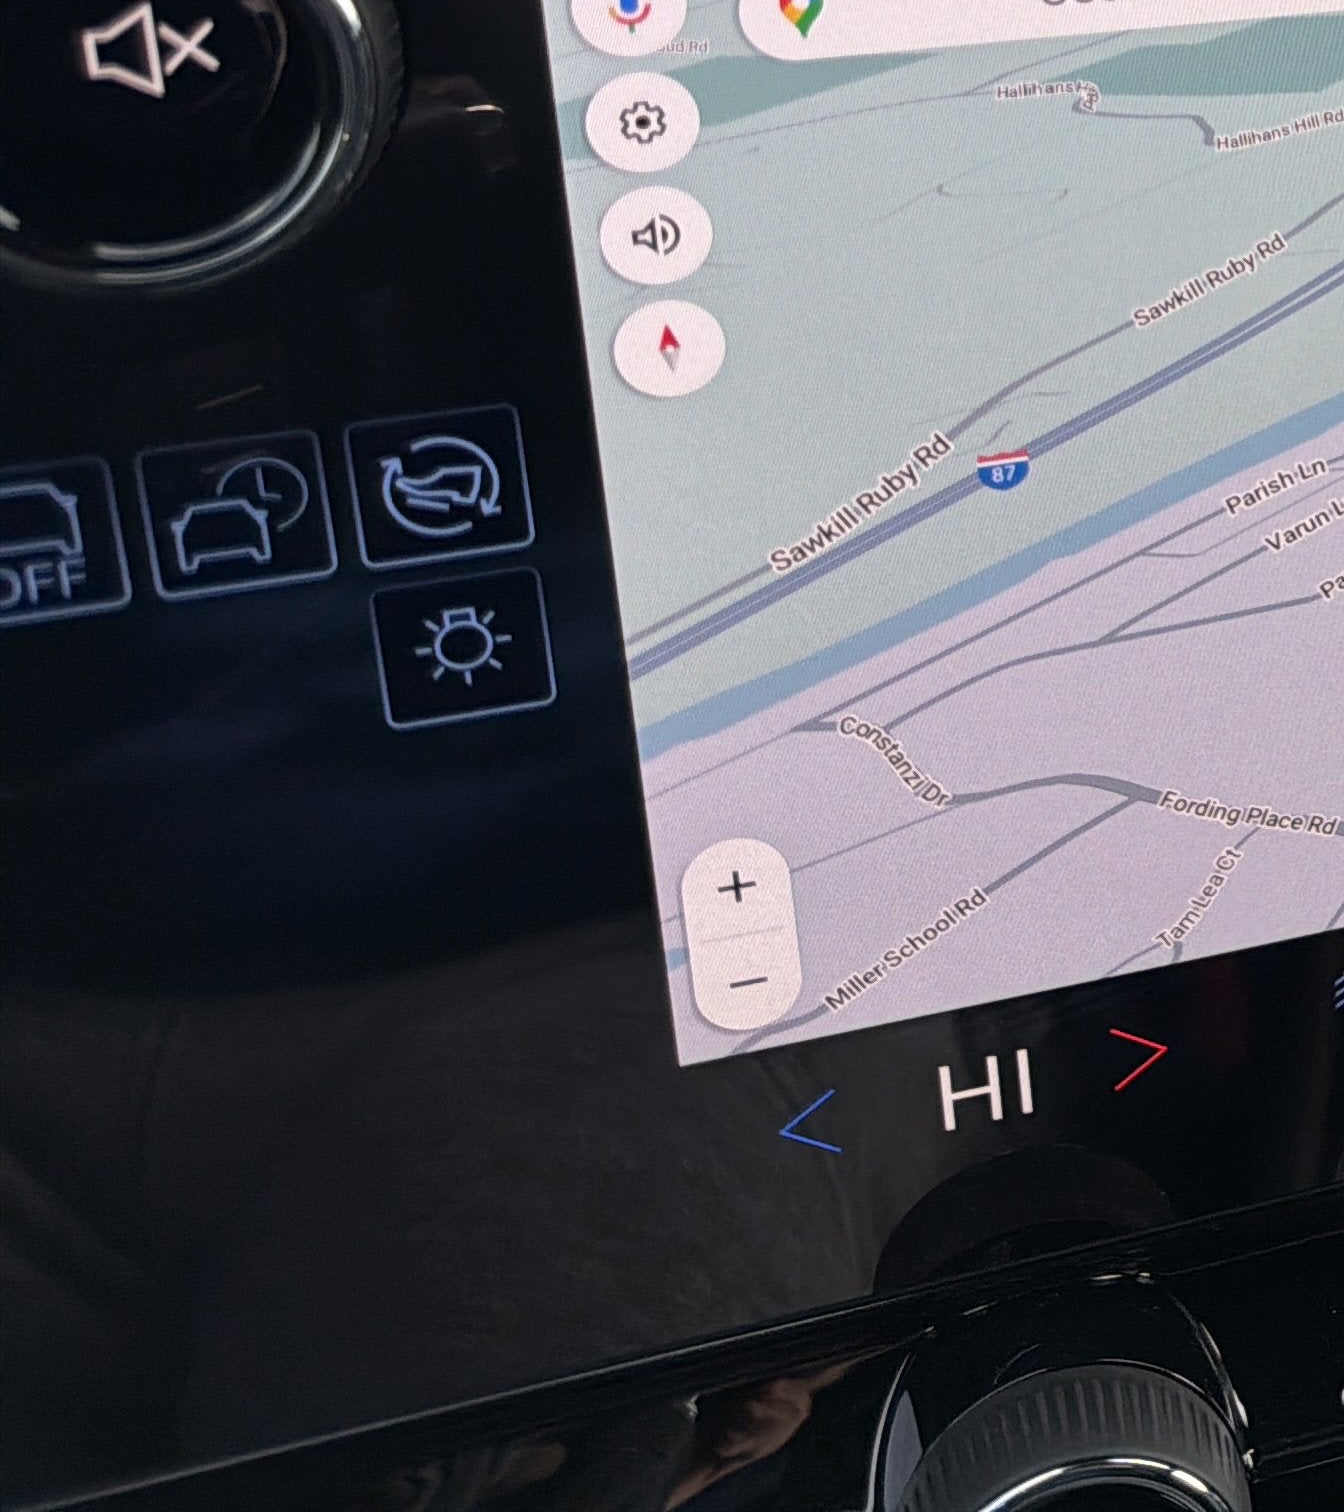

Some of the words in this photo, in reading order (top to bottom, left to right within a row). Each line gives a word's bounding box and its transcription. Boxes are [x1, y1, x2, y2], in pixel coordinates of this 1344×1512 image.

[689, 40, 708, 53] Rd
[1216, 125, 1290, 150] Hallihans
[1295, 116, 1321, 133] Hill
[1324, 110, 1344, 125] Rd
[1134, 279, 1205, 326] Sawkill
[1206, 254, 1255, 288] Ruby
[1256, 233, 1285, 259] Rd
[771, 506, 860, 572] Sawkill
[856, 464, 918, 515] Ruby
[913, 433, 951, 468] Rd
[991, 465, 1016, 483] 87
[1225, 472, 1295, 514] Parish
[1297, 460, 1326, 480] Ln
[1265, 510, 1331, 551] Varun
[841, 716, 925, 791] Constanzi
[921, 782, 949, 806] Dr
[1159, 791, 1241, 827] Fording
[1245, 807, 1304, 831] Place
[1307, 817, 1337, 835] Rd
[1155, 906, 1198, 948] Tam
[1194, 870, 1224, 910] Lea
[1216, 848, 1243, 872] Ct
[825, 963, 886, 1012] Miller
[882, 910, 956, 970] School
[955, 889, 987, 918] Rd
[937, 1048, 1034, 1131] HI
